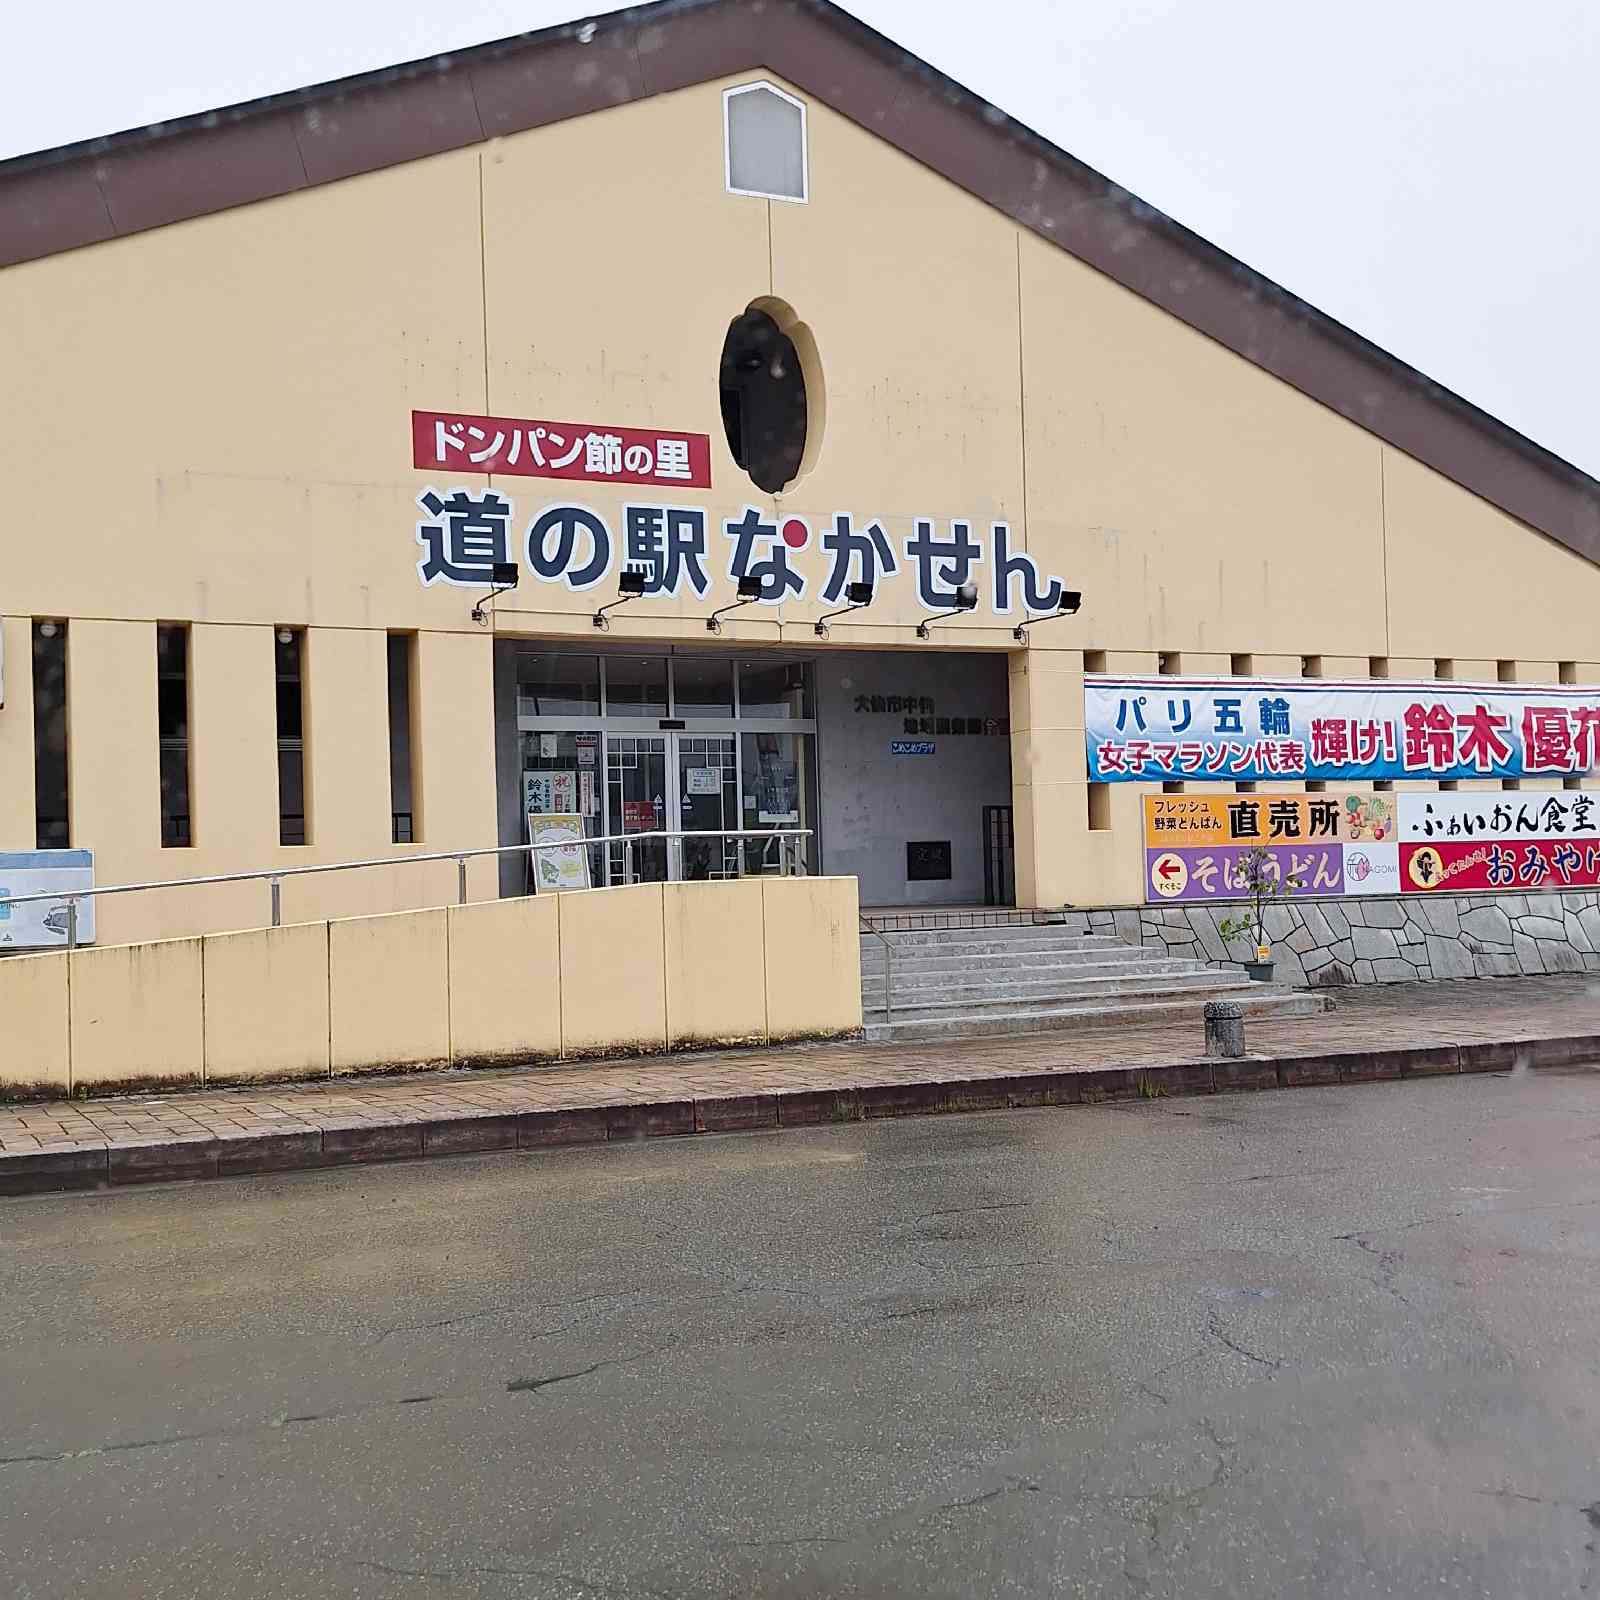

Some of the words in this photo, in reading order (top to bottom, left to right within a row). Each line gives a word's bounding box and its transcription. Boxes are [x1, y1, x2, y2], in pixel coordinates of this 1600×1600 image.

[435, 420, 692, 480] ドンパン節の里
[1115, 697, 1290, 735] パリ五輪
[1098, 739, 1304, 773] 女子マラソン代表
[1155, 801, 1209, 814] フレッシュ
[1227, 800, 1340, 838] 直売所
[1412, 795, 1596, 836] ふぁいおん食堂
